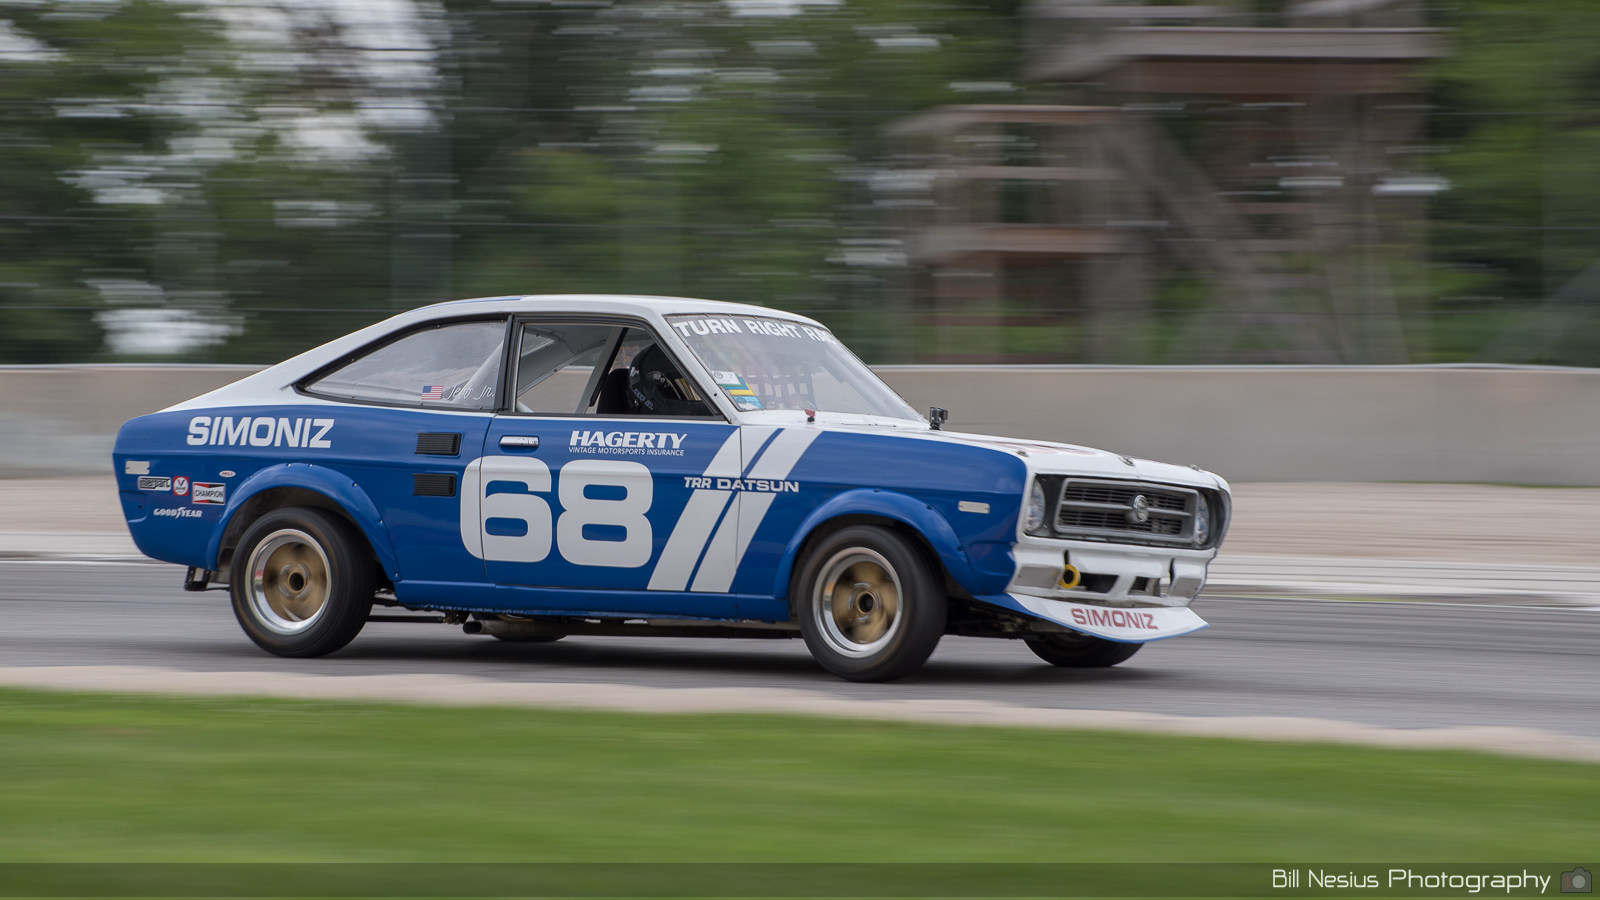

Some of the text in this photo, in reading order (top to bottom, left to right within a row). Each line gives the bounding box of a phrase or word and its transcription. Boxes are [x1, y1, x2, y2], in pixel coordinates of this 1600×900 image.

[672, 318, 743, 338] TURN
[742, 319, 802, 339] RIGHT
[443, 385, 473, 400] Jeff
[187, 416, 335, 448] SIMONIZ
[569, 431, 687, 448] HAGERTY
[598, 447, 645, 455] MOTORSPORTS
[684, 476, 800, 493] TRR DATSUN
[194, 489, 225, 498] CHAMPION
[153, 506, 203, 519] GOODYEAR
[460, 455, 653, 569] 68
[1071, 608, 1158, 629] SIMONIZ
